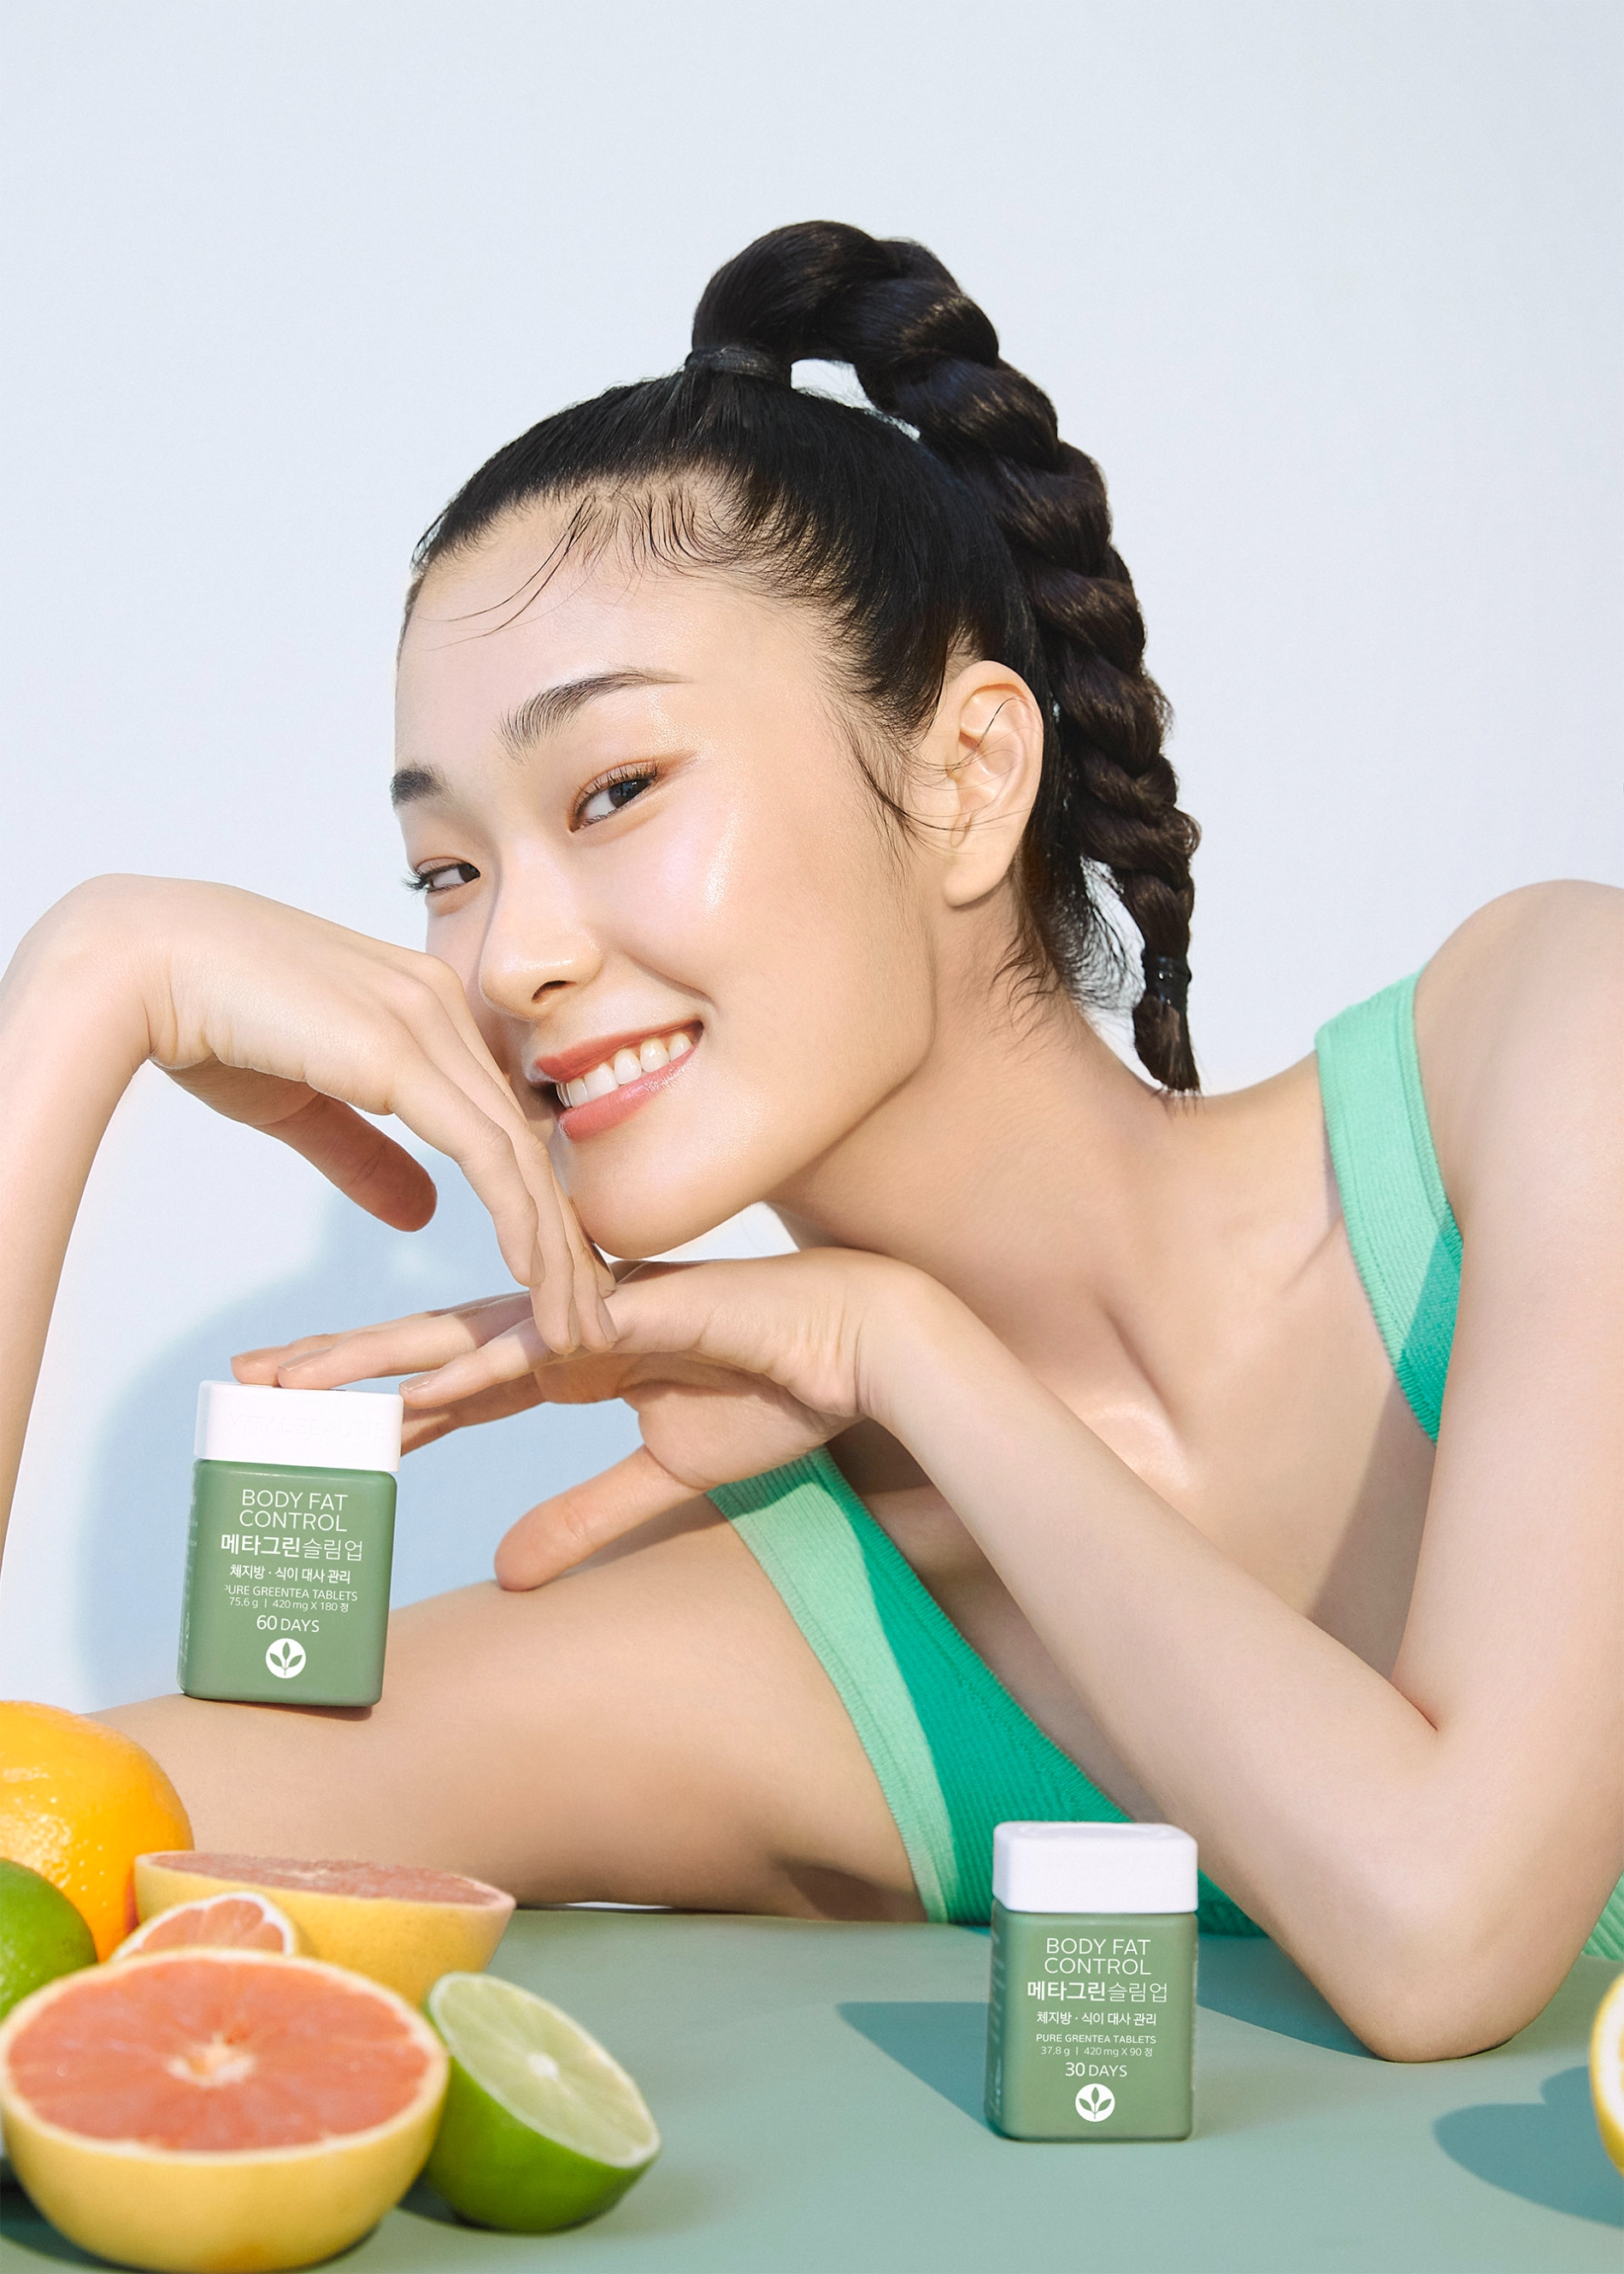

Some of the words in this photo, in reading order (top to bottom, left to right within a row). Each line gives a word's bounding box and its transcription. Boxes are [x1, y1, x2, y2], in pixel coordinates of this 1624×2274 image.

[242, 1488, 303, 1509] BODY
[309, 1493, 349, 1511] FAT
[239, 1509, 348, 1532] CONTROL
[229, 1564, 266, 1580] 체지방
[274, 1566, 298, 1582] 식이
[302, 1568, 326, 1583] 대사
[327, 1570, 350, 1584] 관리
[252, 1586, 309, 1599] GREENTEA
[312, 1589, 358, 1601] TABLETS
[229, 1596, 250, 1606] 75.6
[310, 1601, 317, 1610] X
[321, 1601, 338, 1611] 180
[339, 1602, 349, 1613] 정
[256, 1614, 278, 1630] 60
[280, 1617, 320, 1633] DAYS
[1046, 1937, 1107, 1954] BODY
[1113, 1939, 1151, 1955] FAT
[1044, 1957, 1151, 1976] CONTROL
[1037, 2011, 1073, 2025] 체지방
[1081, 2012, 1104, 2025] 식이
[1107, 2012, 1132, 2025] 대사
[1133, 2012, 1156, 2026] 관리
[1036, 2034, 1062, 2042] PURE
[1064, 2034, 1111, 2043] GRENTEA
[1113, 2035, 1156, 2044] TABLETS
[1041, 2046, 1062, 2055] 37.8
[1121, 2047, 1127, 2056] X
[1129, 2047, 1142, 2056] 90
[1144, 2047, 1153, 2057] 정
[1065, 2062, 1086, 2077] 30
[1088, 2065, 1127, 2077] DAYS
